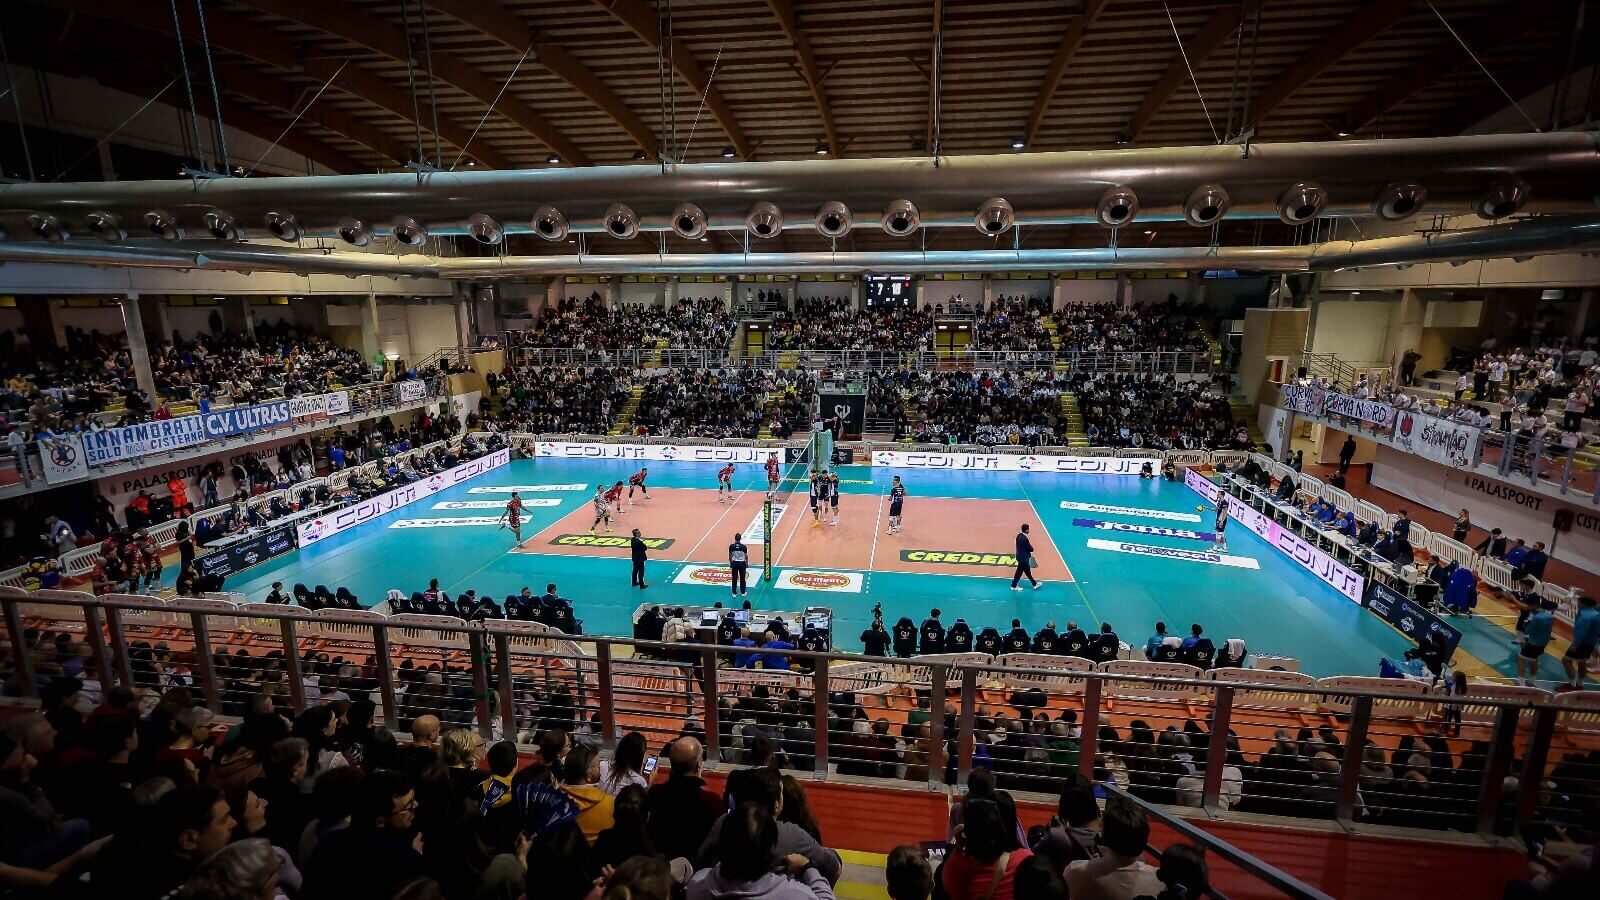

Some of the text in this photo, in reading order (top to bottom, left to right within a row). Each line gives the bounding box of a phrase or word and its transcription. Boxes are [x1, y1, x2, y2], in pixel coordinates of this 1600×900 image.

[206, 412, 234, 435] C.V.
[234, 402, 289, 430] ULTRAS
[1326, 394, 1354, 415] CURVA
[84, 414, 201, 451] INNAMORATI
[88, 448, 121, 462] SOLO
[150, 430, 205, 450] CISTERNA
[453, 451, 506, 482] CONIT
[565, 445, 644, 458] CONIT
[905, 454, 997, 468] CONIT
[336, 486, 415, 530] CONIT
[1470, 477, 1544, 511] PALASPORT
[1278, 532, 1357, 591] CONIT
